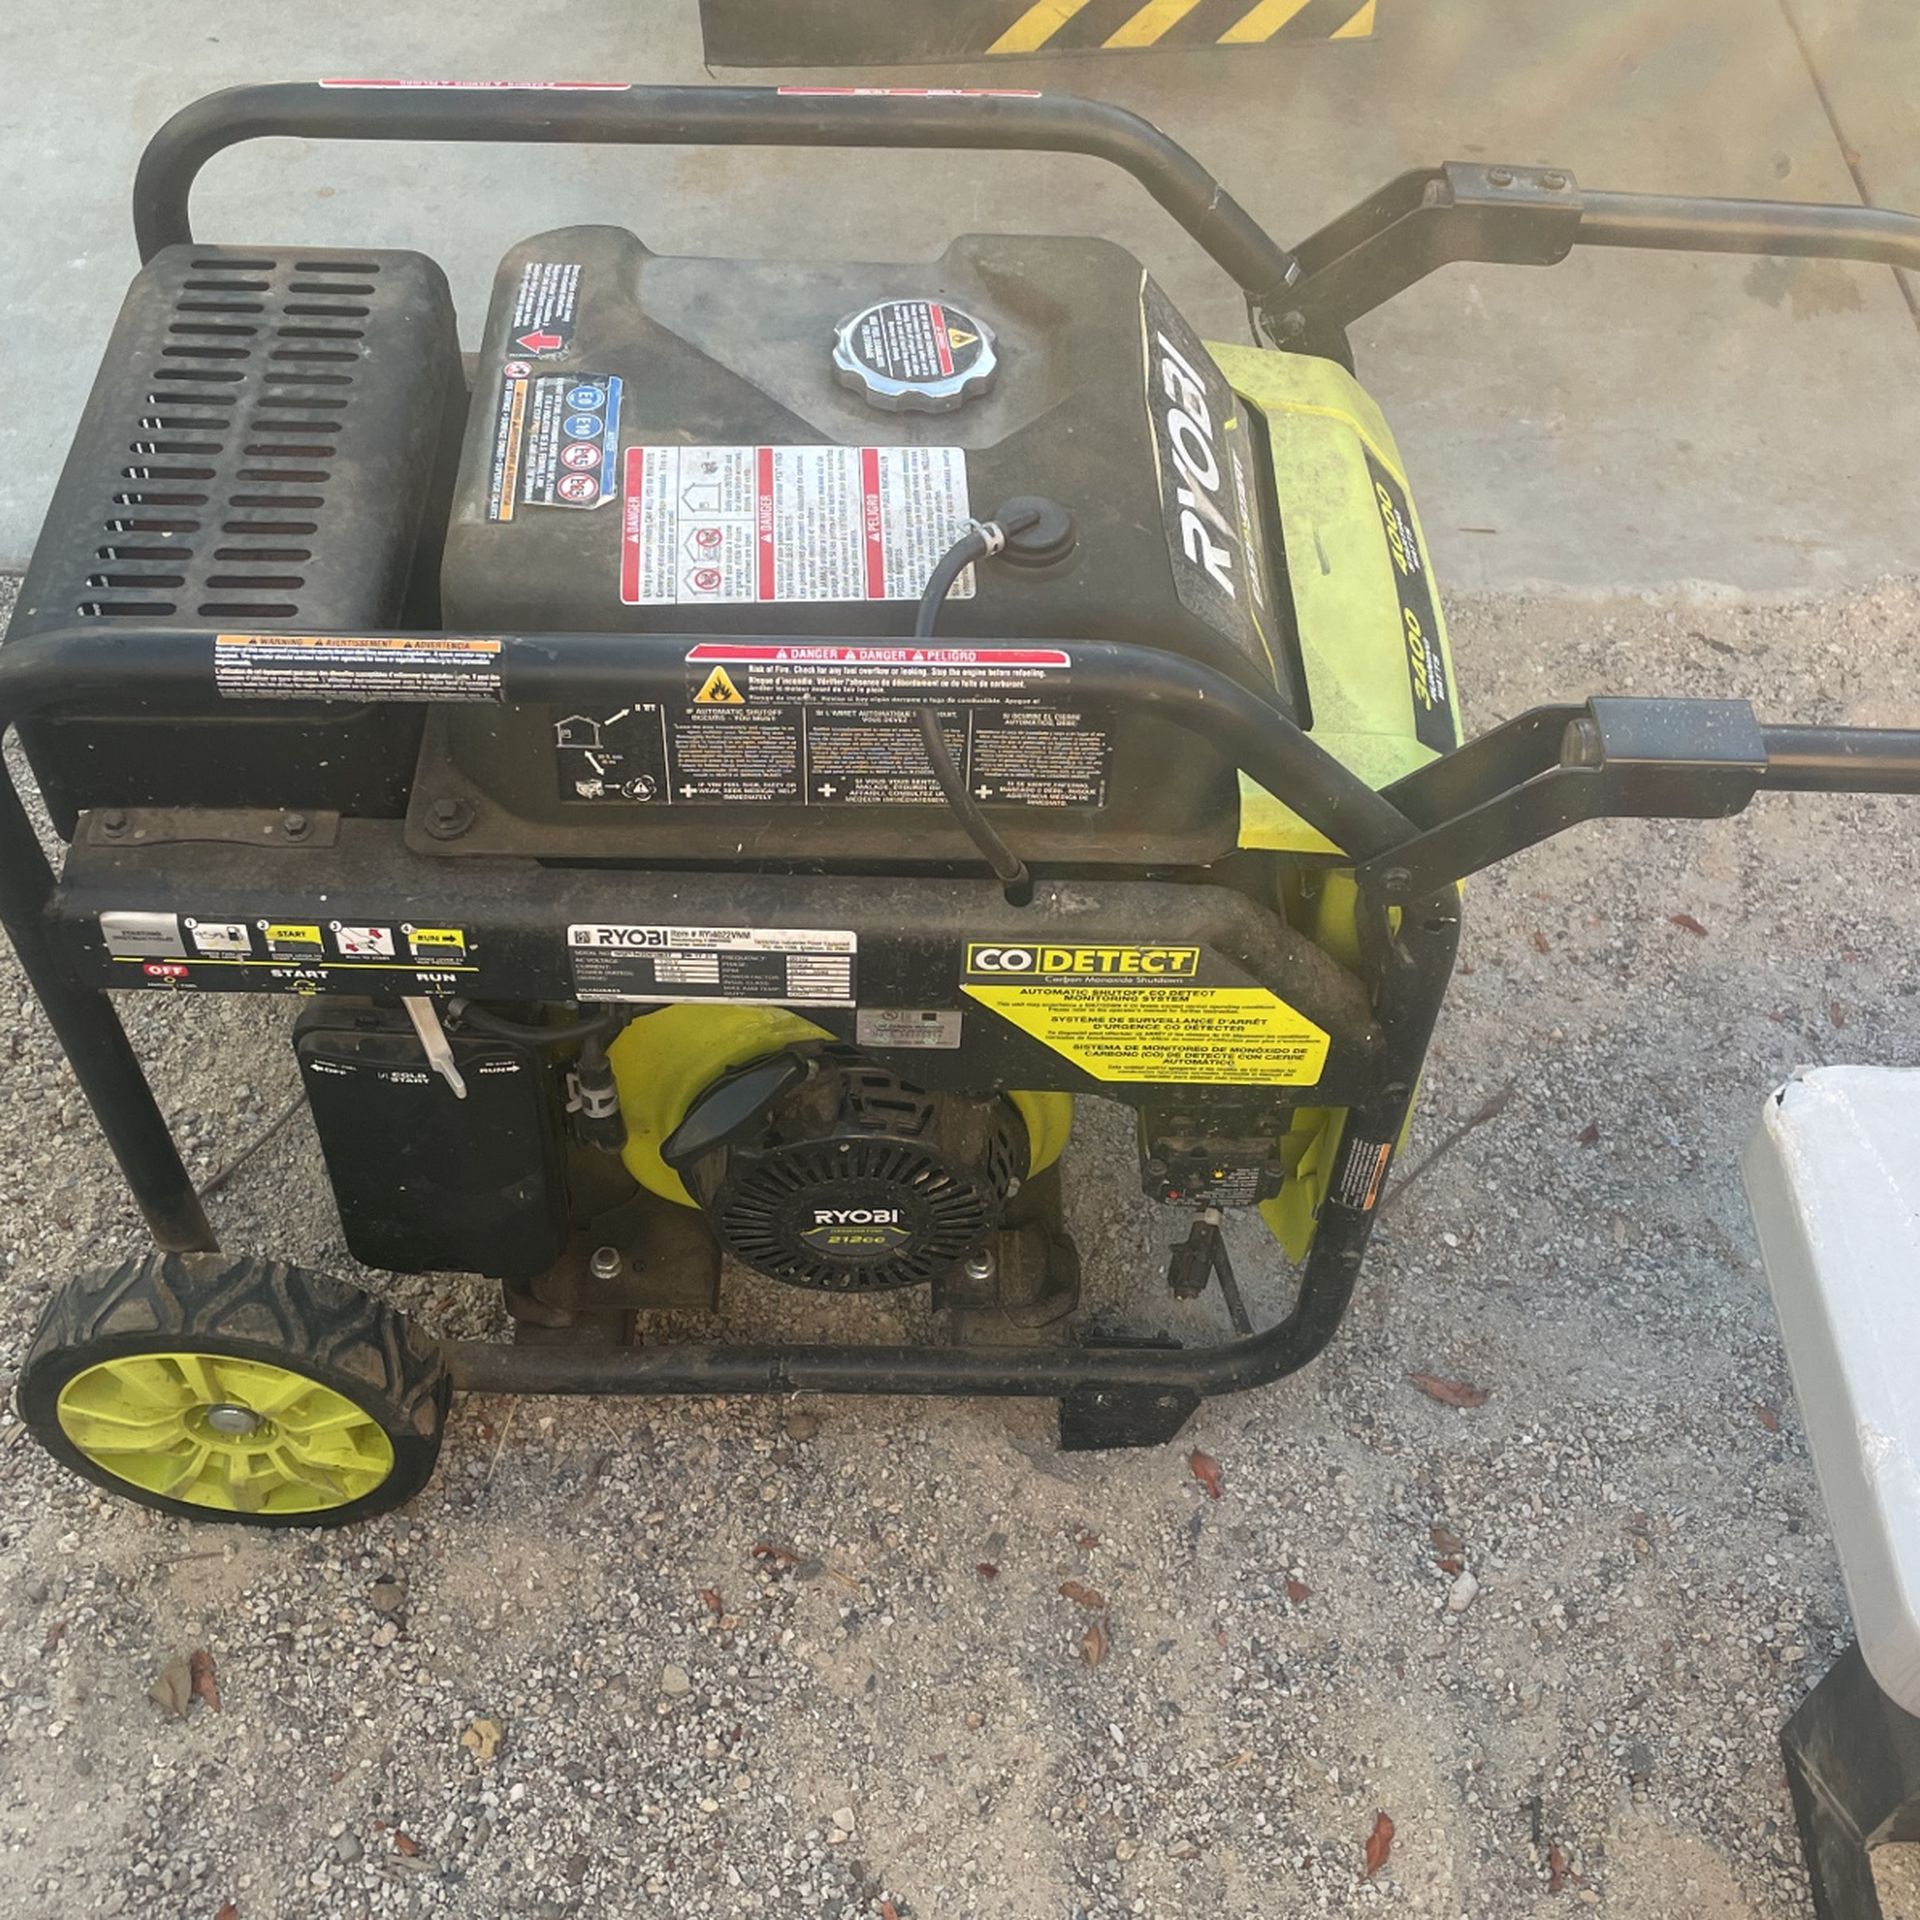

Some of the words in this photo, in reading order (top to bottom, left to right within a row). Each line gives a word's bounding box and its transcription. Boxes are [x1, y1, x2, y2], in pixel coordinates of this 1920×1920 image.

[578, 391, 593, 405] E0
[576, 418, 591, 434] E10
[1157, 331, 1237, 599] RYOBI
[627, 496, 640, 532] DANGER
[760, 495, 772, 531] DANGER
[867, 493, 879, 531] PELIGRO
[1376, 482, 1407, 576] 4000
[414, 641, 470, 649] ADVERTENCIA
[791, 649, 838, 659] DANGER
[860, 650, 906, 660] DANGER
[928, 651, 977, 662] PELIGRO
[1404, 607, 1431, 711] 3400
[277, 930, 306, 938] START
[597, 929, 668, 945] RYOBI
[975, 949, 1032, 970] CO
[1043, 950, 1192, 972] DETECT
[148, 966, 183, 975] OFF
[270, 969, 329, 979] START
[416, 973, 456, 982] RUN
[1045, 976, 1082, 984] Carbon
[1084, 976, 1133, 984] Monoxide
[1020, 988, 1087, 996] AUTOMATIC
[1218, 1017, 1268, 1025] D'ARRÊT
[1141, 1051, 1164, 1059] (CO)
[1230, 1045, 1290, 1054] MONÓXIDO
[814, 1209, 899, 1224] RYOBI
